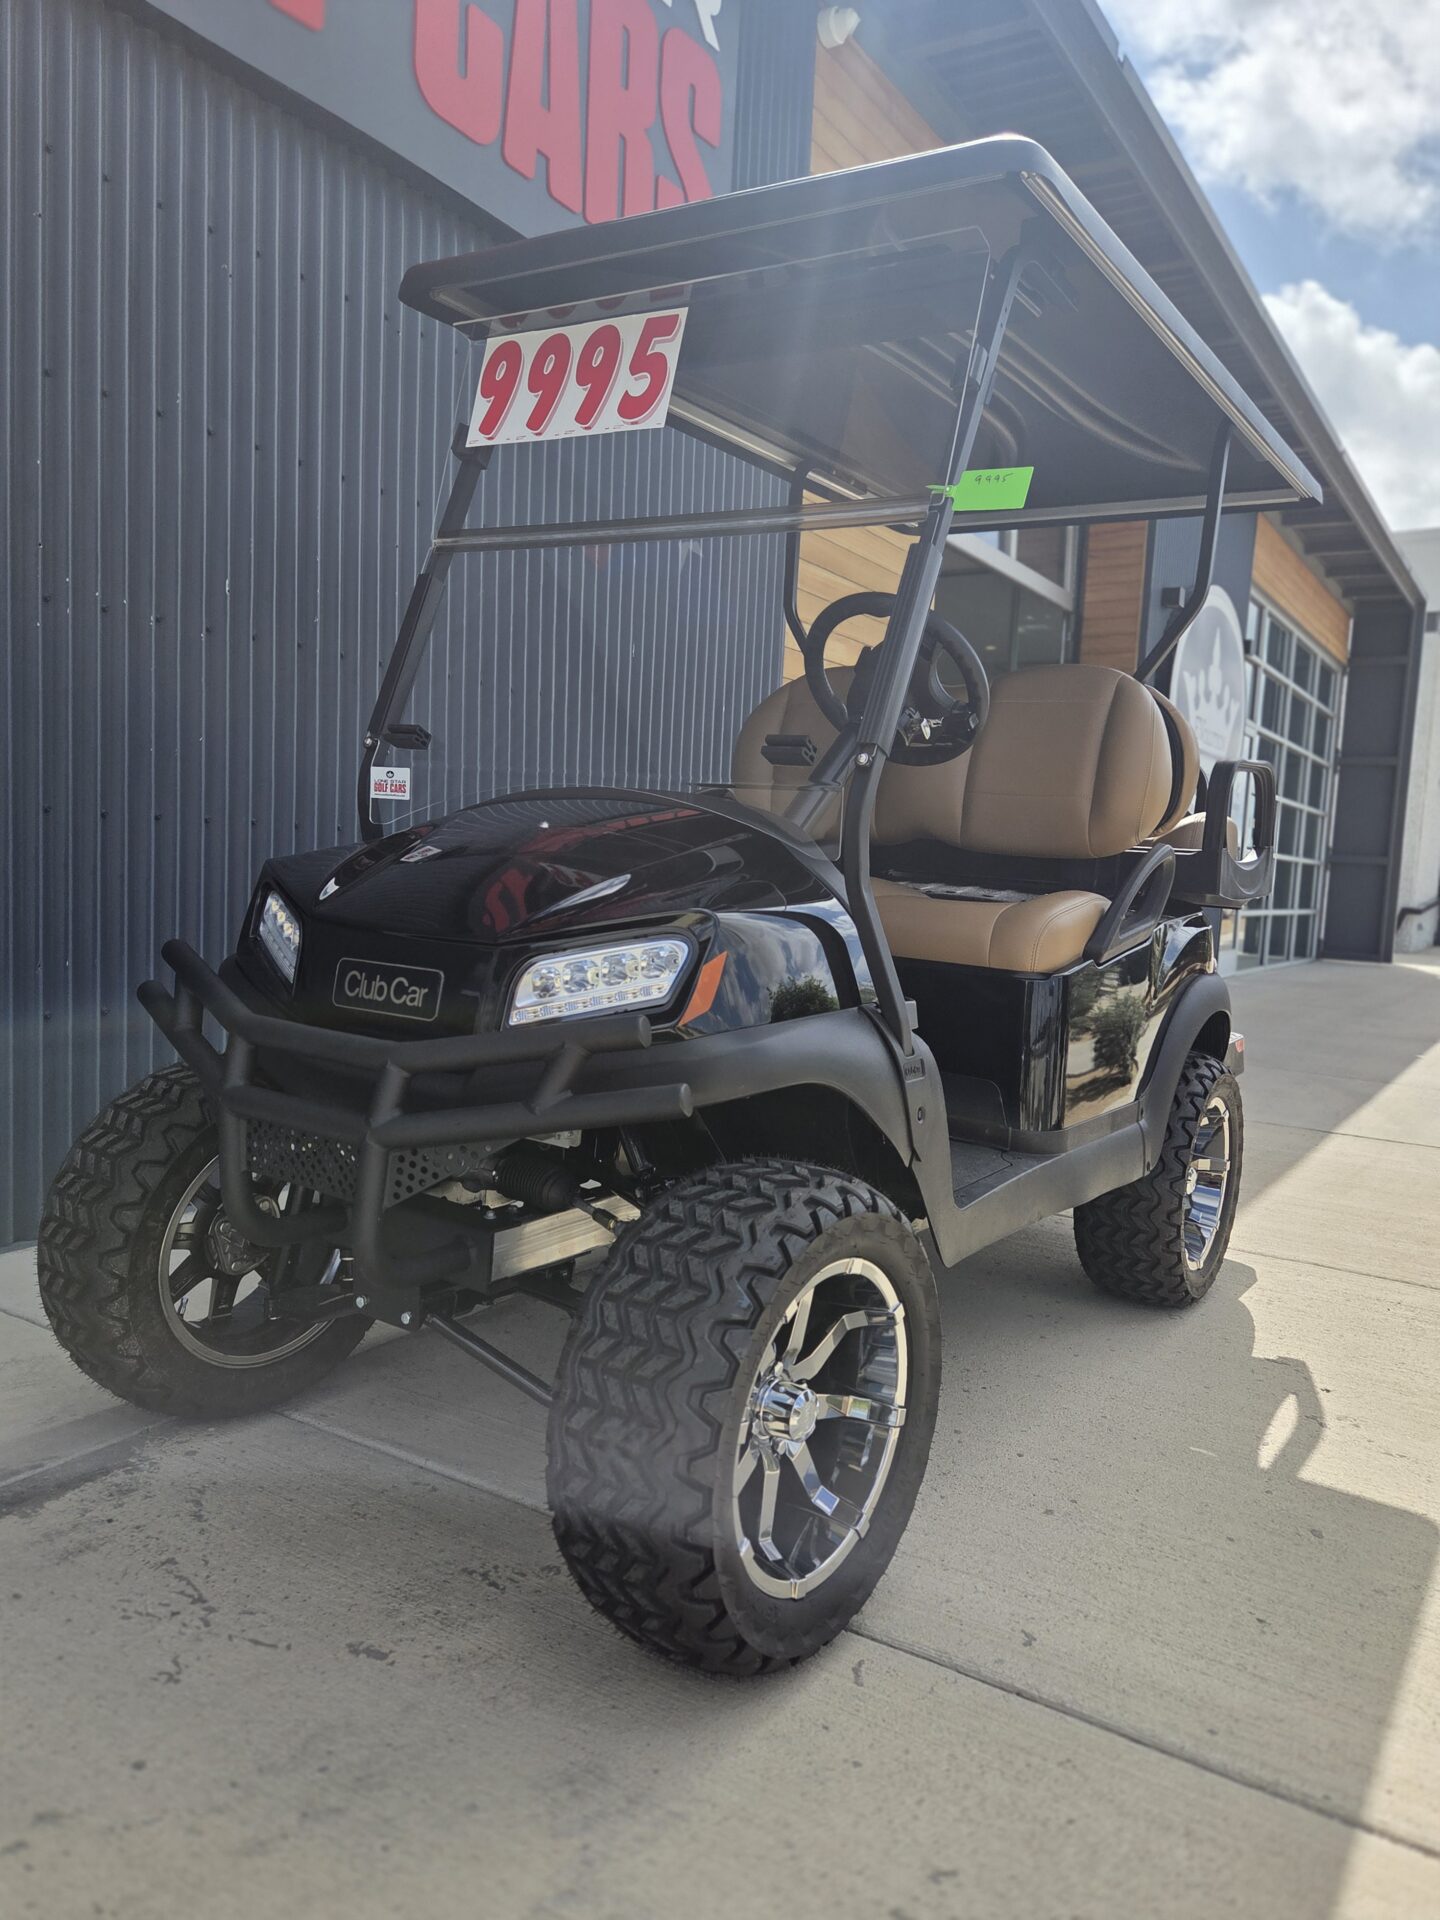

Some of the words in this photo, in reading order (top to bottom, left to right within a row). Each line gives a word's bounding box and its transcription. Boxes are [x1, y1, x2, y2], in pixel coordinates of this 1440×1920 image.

[478, 313, 682, 441] 9995
[374, 783, 388, 792] GOLF
[390, 784, 406, 793] CARS
[345, 970, 388, 1001] Club
[390, 977, 429, 1007] Car
